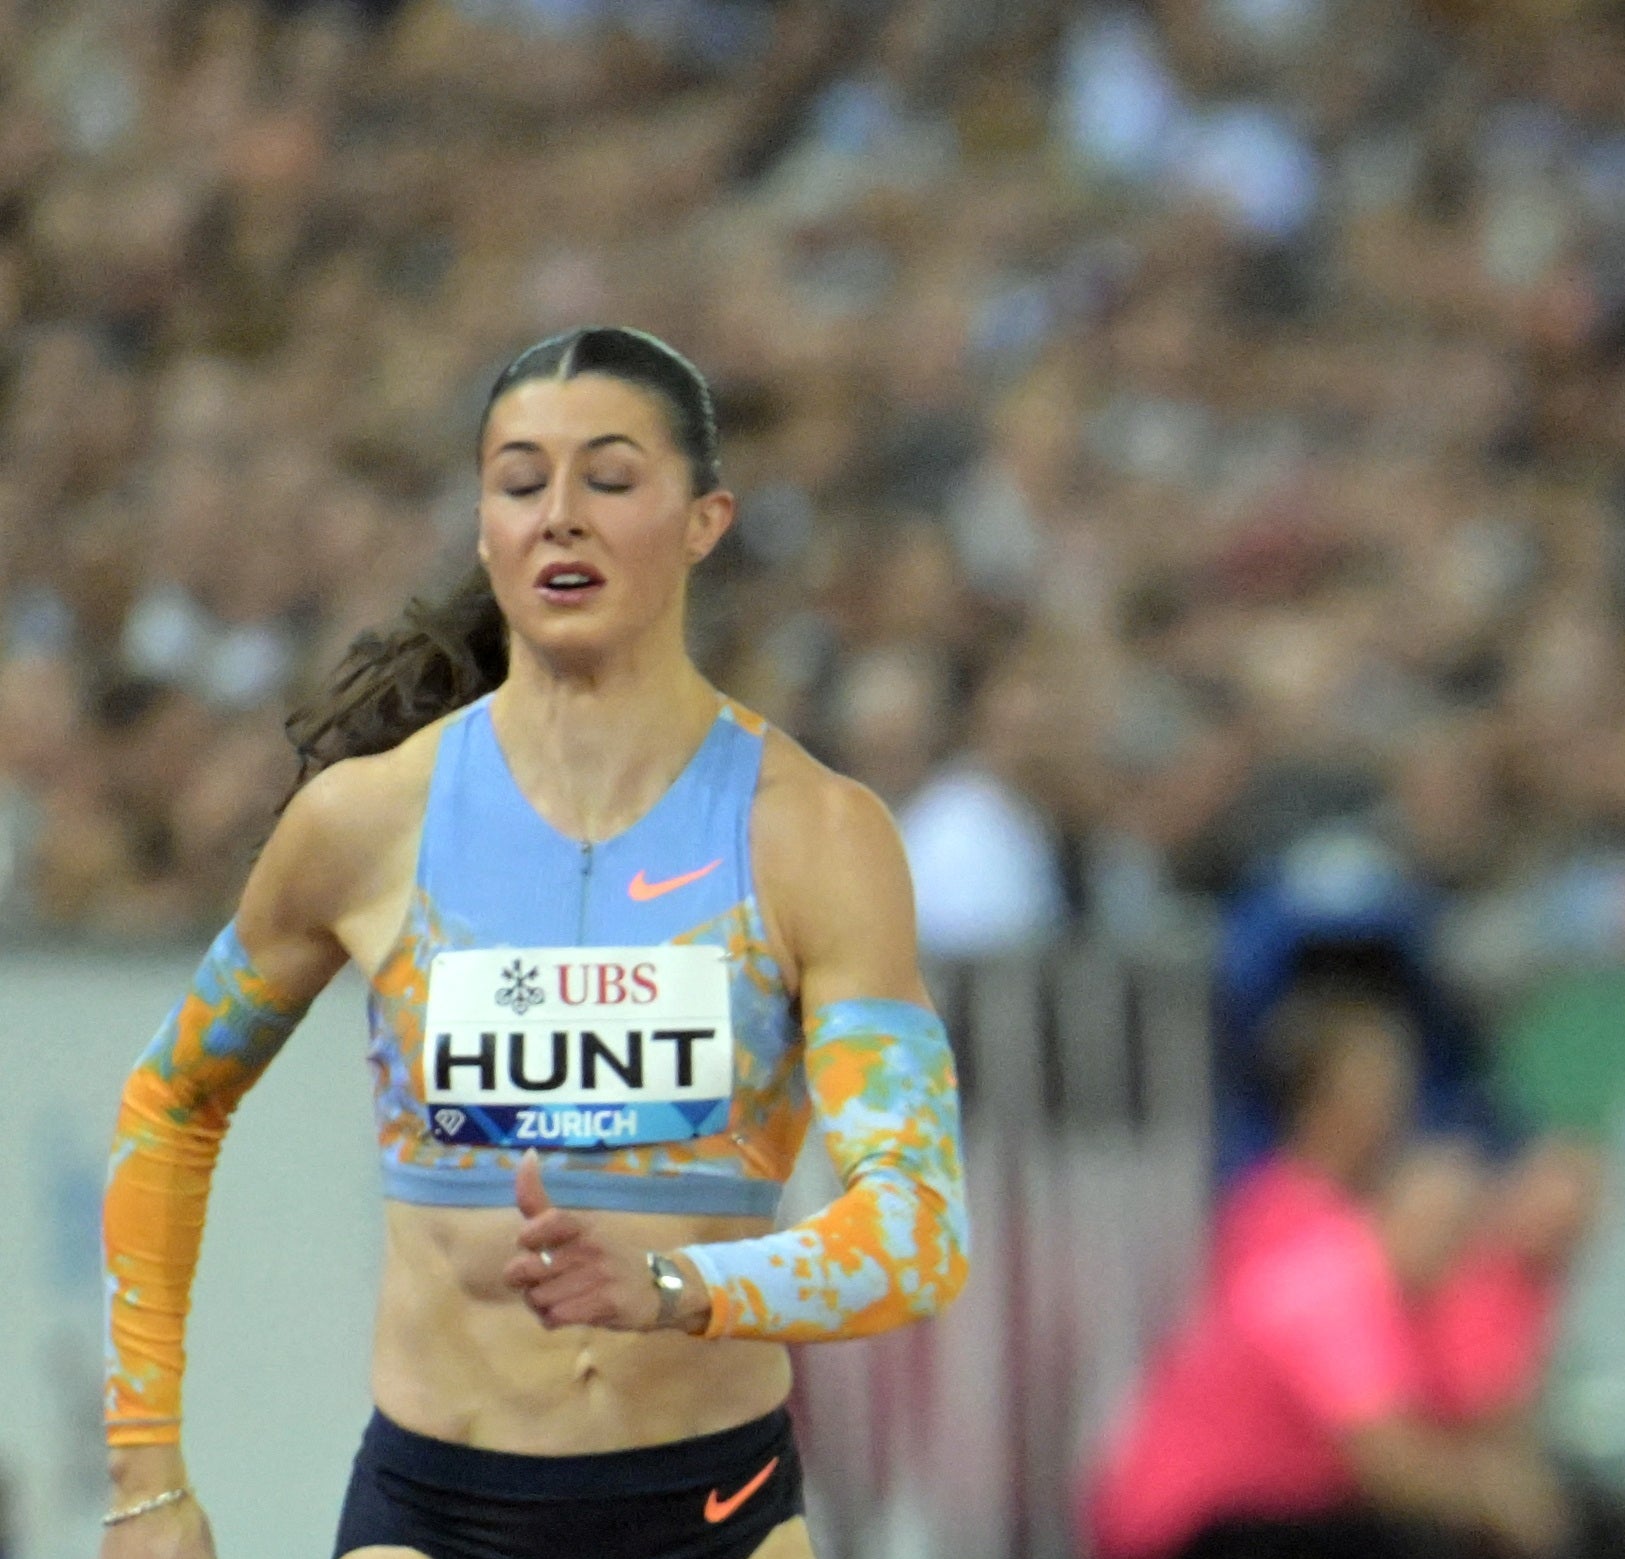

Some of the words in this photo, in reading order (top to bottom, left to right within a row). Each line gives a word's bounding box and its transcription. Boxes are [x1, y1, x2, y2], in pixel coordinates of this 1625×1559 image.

[556, 962, 659, 1006] UBS
[434, 1029, 716, 1091] HUNT
[516, 1109, 638, 1140] ZURICH
